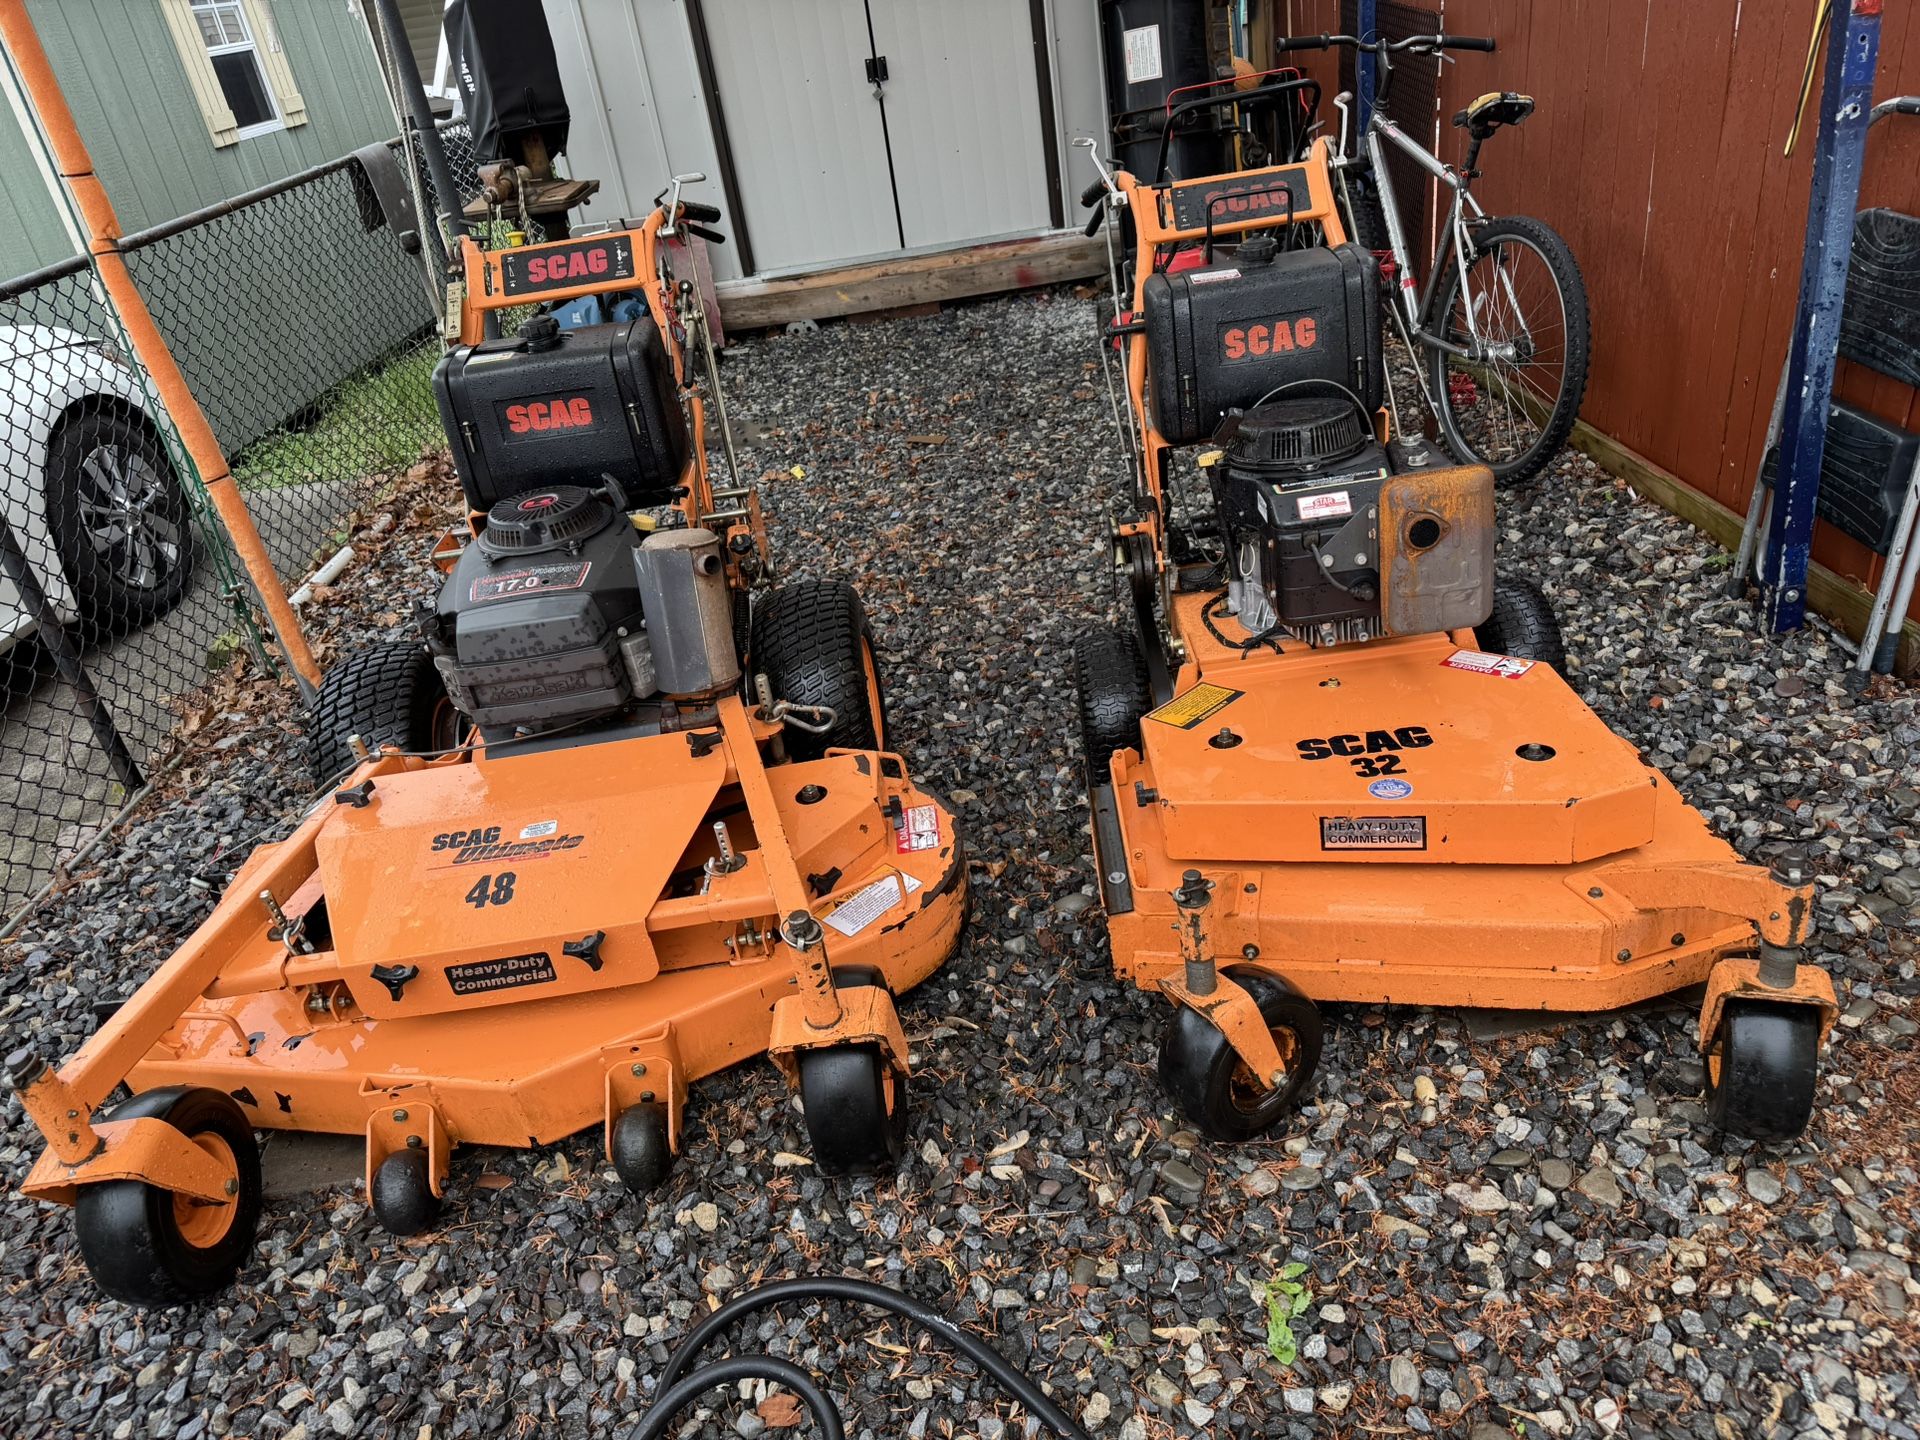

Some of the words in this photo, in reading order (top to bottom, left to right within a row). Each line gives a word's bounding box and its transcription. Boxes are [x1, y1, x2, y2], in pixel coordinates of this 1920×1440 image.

[1205, 181, 1290, 216] SCAG
[528, 249, 608, 283] SCAG
[1224, 318, 1316, 359] SCAG
[506, 397, 593, 433] SCAG
[496, 576, 539, 593] 17.0
[1450, 662, 1493, 674] DANGER
[492, 672, 586, 702] Kawasaki
[1296, 727, 1434, 760] SCAG
[1350, 754, 1408, 778] 32
[431, 826, 501, 851] SCAG
[452, 834, 585, 864] Ultimate
[1328, 834, 1418, 845] COMMERCIAL
[465, 872, 517, 908] 48
[451, 957, 546, 978] Heavy-Duty
[454, 968, 553, 991] Commercial
